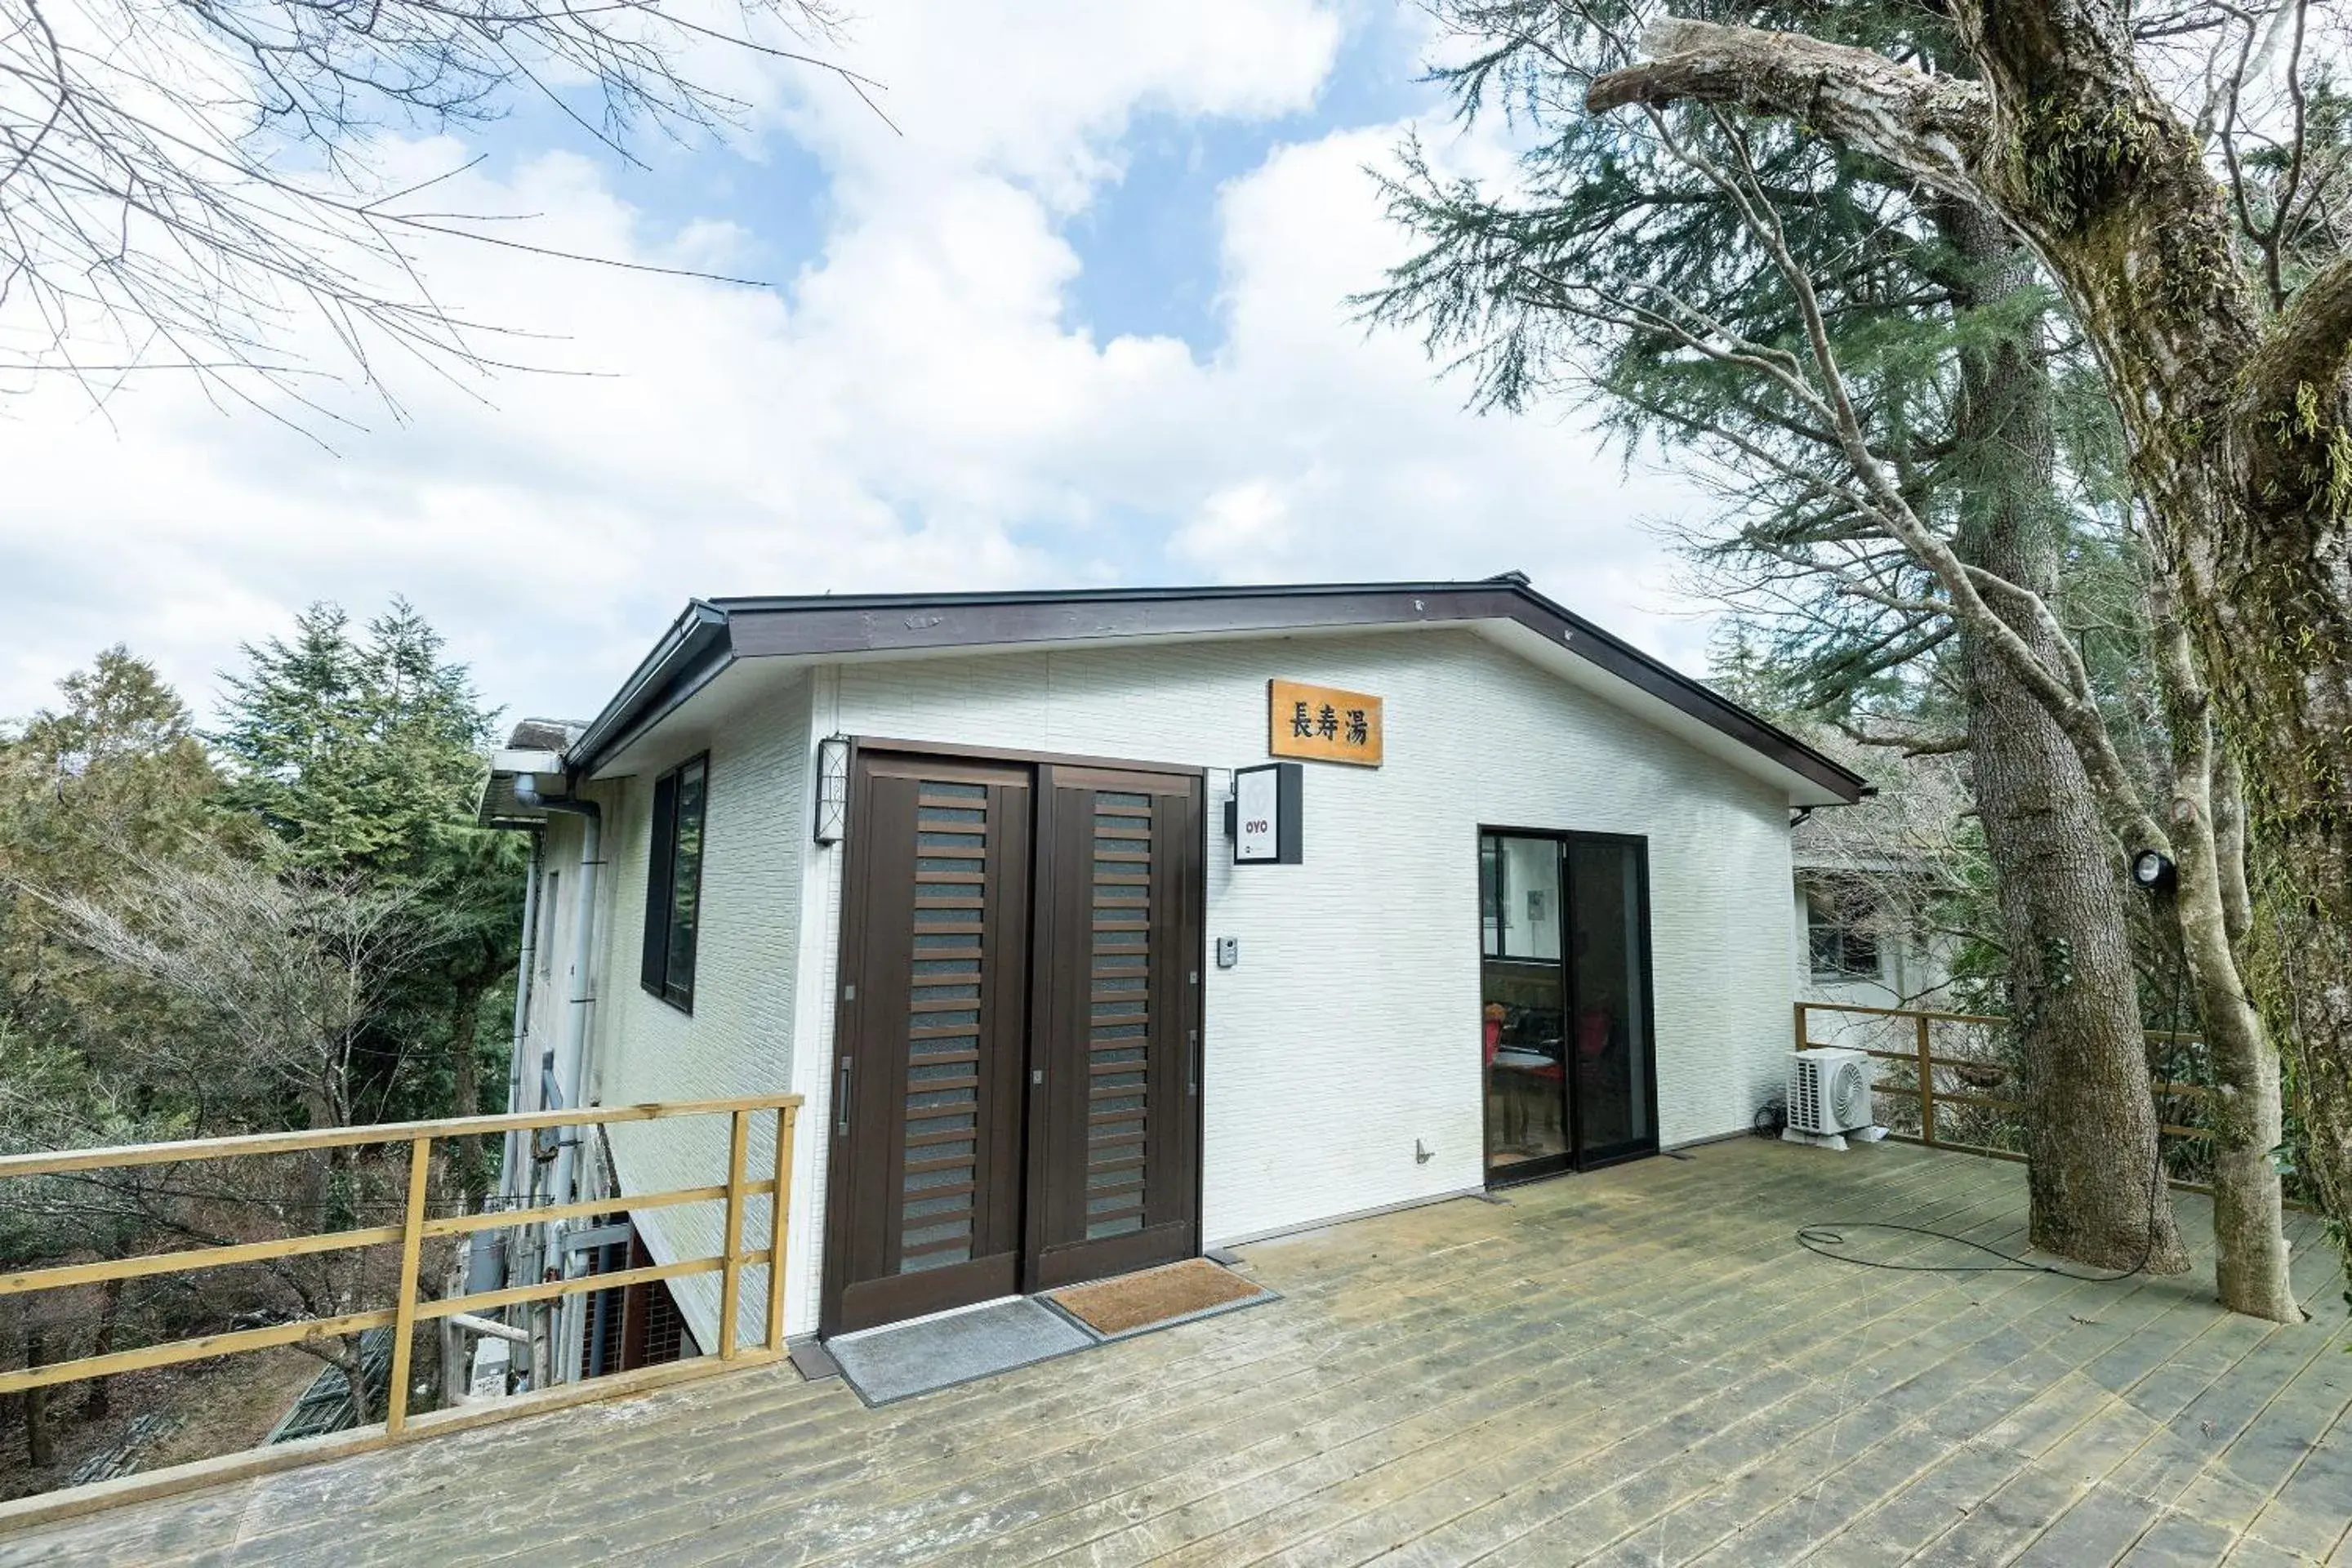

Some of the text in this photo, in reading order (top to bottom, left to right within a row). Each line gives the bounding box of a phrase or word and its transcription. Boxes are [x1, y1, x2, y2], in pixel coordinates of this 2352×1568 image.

[1290, 702, 1368, 746] 長寿湯
[1245, 819, 1267, 834] OYO
